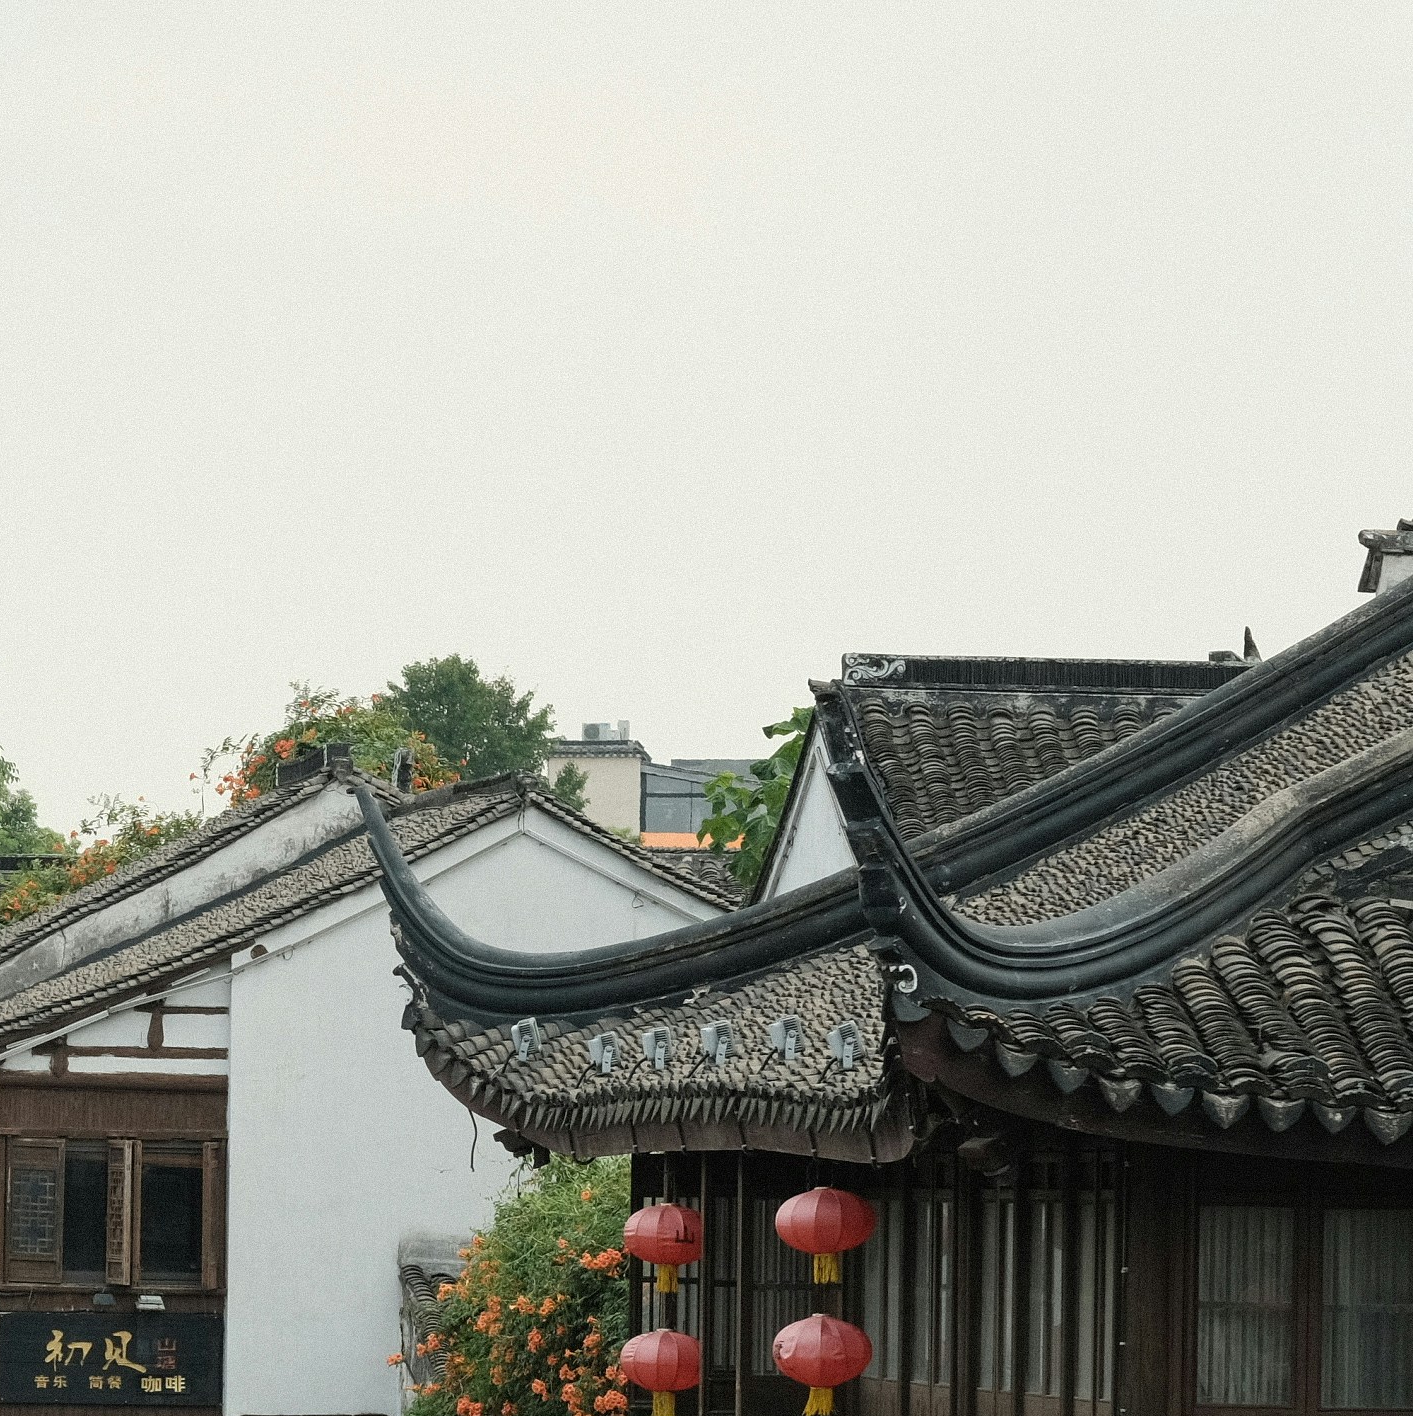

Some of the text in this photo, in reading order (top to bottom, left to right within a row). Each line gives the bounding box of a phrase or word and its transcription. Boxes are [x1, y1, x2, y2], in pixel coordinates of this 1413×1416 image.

[44, 1329, 147, 1373] 初见
[34, 1375, 68, 1389] 音乐
[141, 1375, 186, 1393] 咖啡
